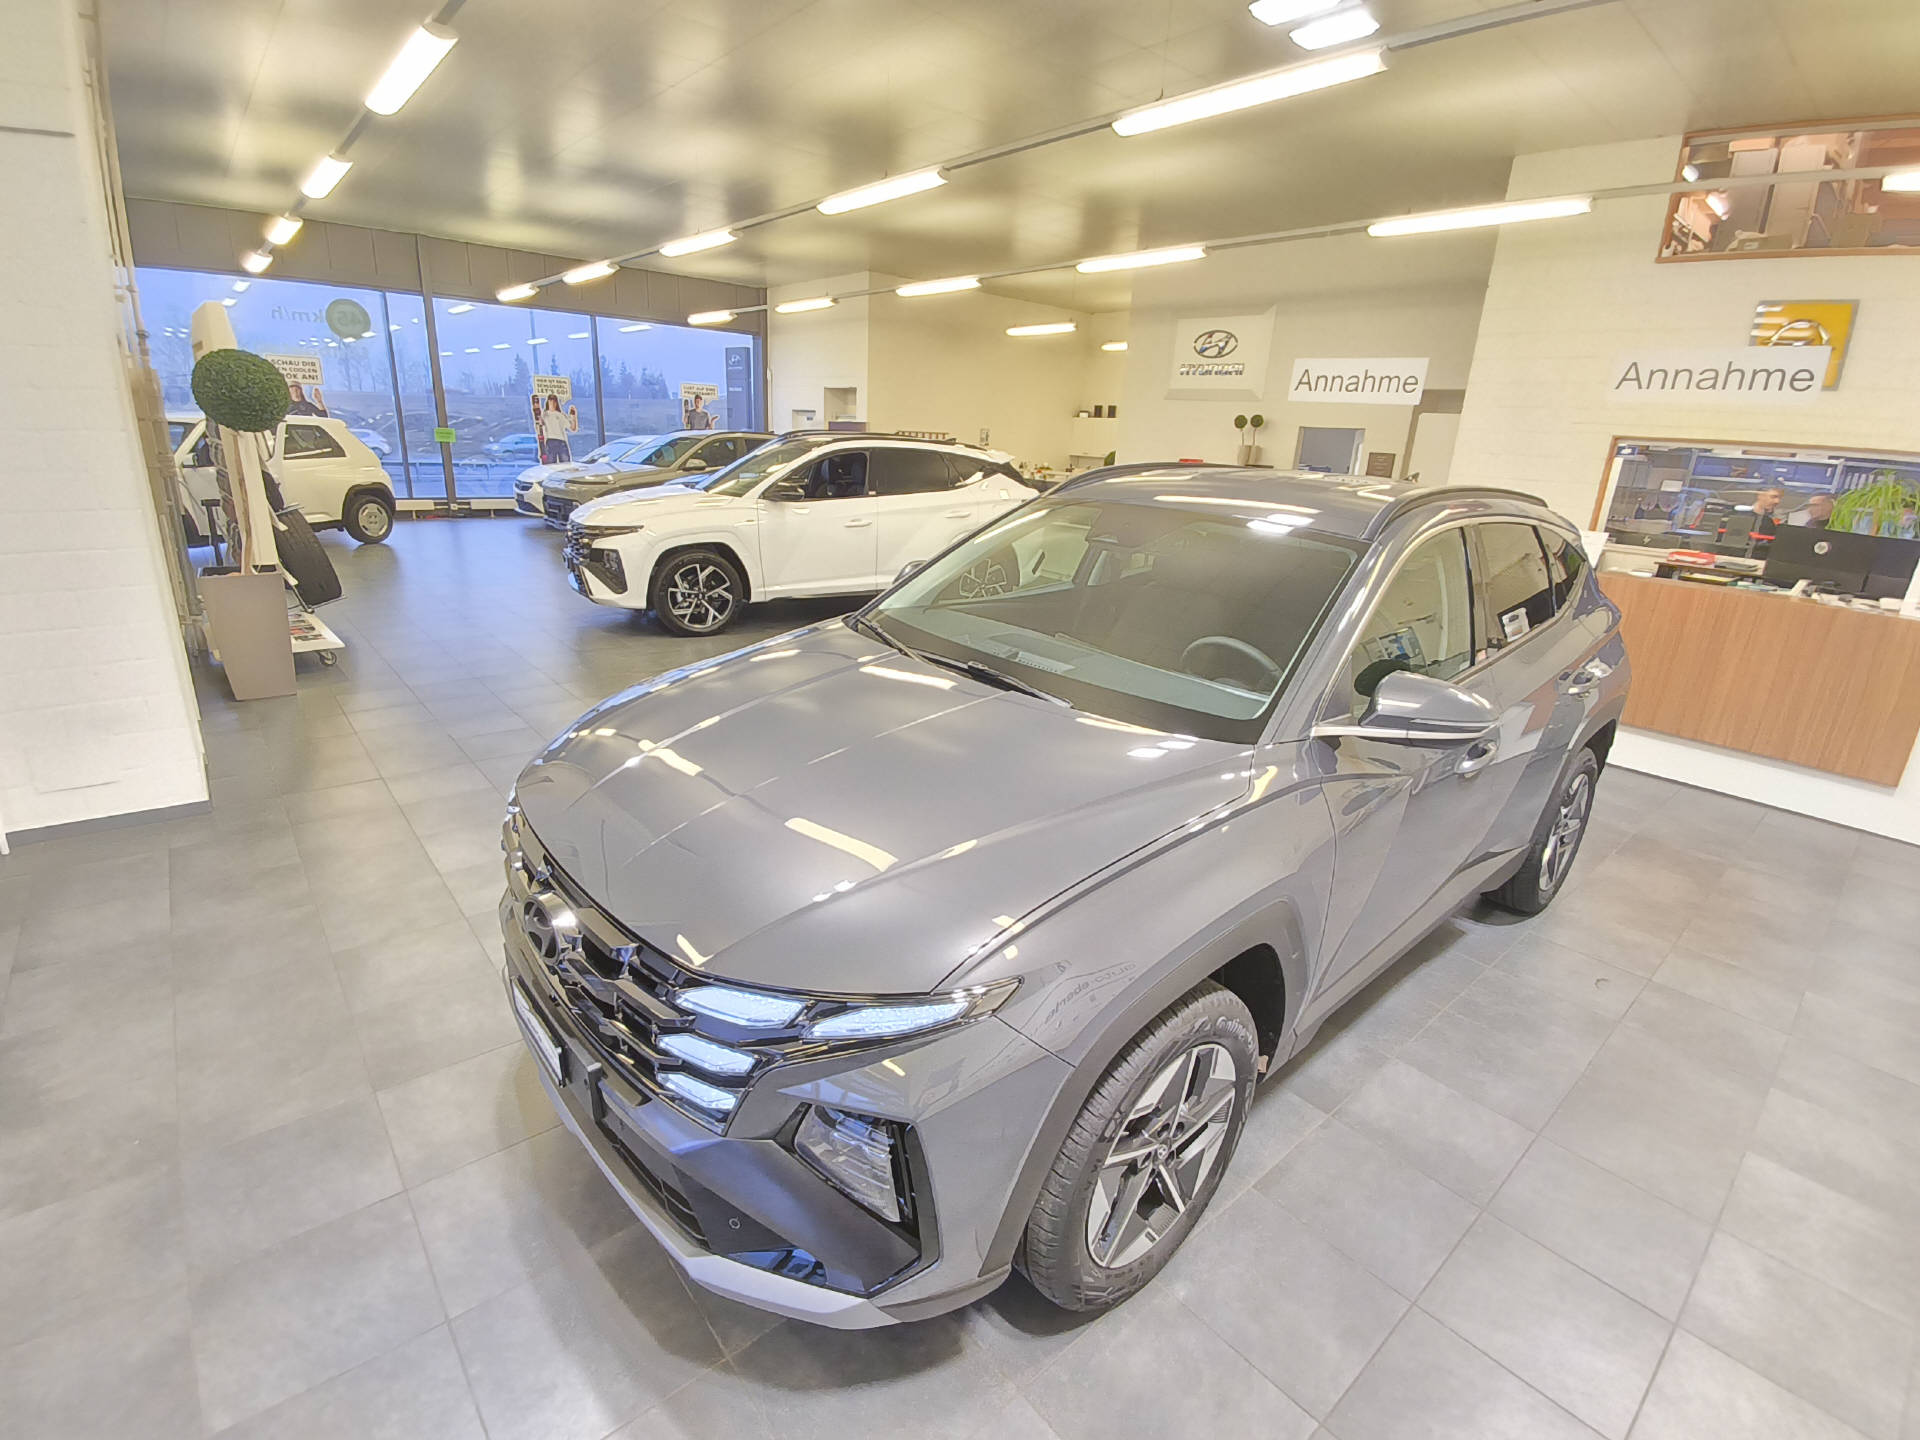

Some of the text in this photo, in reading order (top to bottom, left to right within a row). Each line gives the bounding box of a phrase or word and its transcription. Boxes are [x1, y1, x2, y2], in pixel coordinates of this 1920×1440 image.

[271, 359, 300, 367] SCHAU
[1294, 368, 1419, 394] Annahme
[1615, 361, 1815, 392] Annahme
